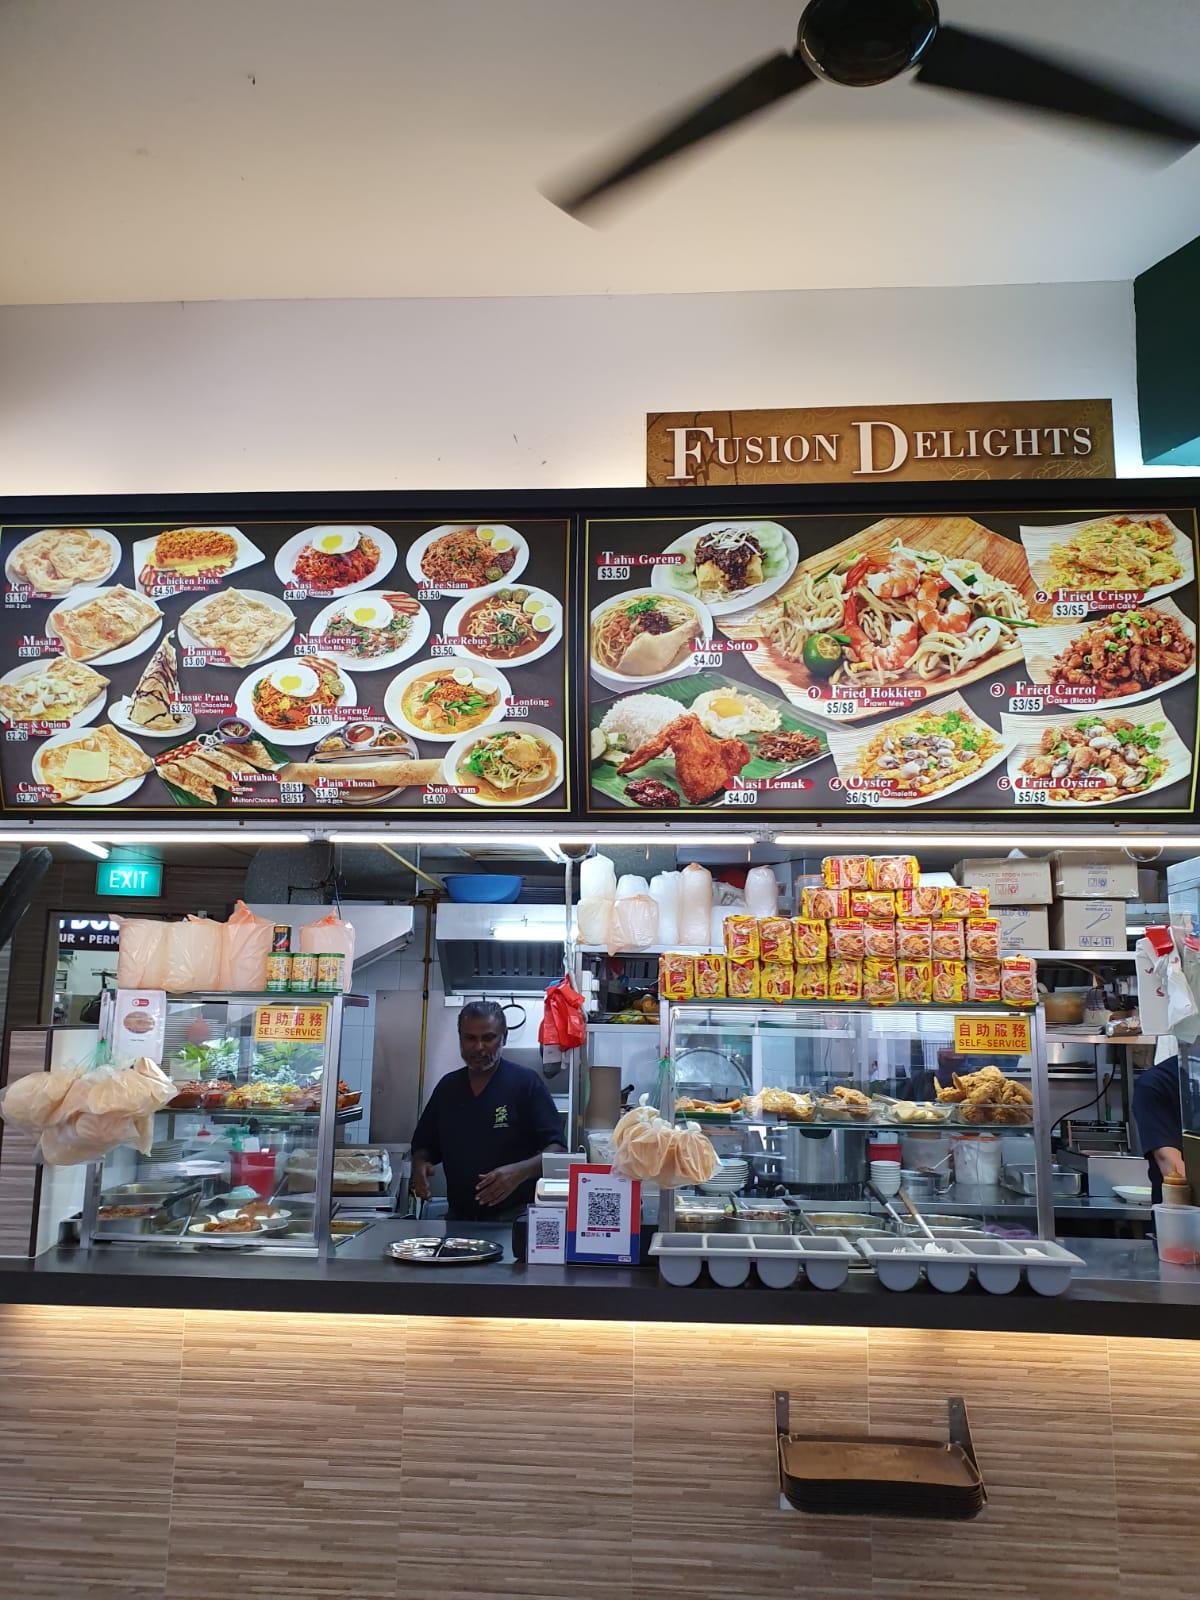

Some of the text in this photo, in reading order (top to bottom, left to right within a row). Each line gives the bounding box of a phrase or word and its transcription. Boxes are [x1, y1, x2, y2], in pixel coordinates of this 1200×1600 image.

[665, 420, 1094, 481] FUSION DELIGHTS
[601, 551, 682, 566] Tahu Goreng
[157, 573, 220, 585] Chicken Floss
[600, 567, 628, 579] $3.50
[290, 580, 312, 590] Nasi
[421, 579, 469, 590] Mee Siam
[153, 586, 175, 596] $4.50
[285, 590, 306, 600] $4.00
[419, 590, 440, 600] $3.50
[1058, 588, 1094, 601] Fried
[1098, 590, 1139, 603] Crispy
[1056, 604, 1084, 616] $3/$5
[23, 635, 58, 646] Masala
[299, 632, 357, 646] Nasi Goreng
[434, 633, 488, 646] Mee Rebus
[694, 637, 753, 651] Mee Soto
[19, 647, 40, 656] $3.00
[187, 645, 223, 656] Banana
[295, 645, 316, 655] $4.50
[431, 646, 454, 656] $3.50
[184, 656, 205, 666] $3.00
[693, 653, 721, 665] $4.00
[831, 685, 867, 699] Fried
[870, 687, 922, 698] Hokkien
[1015, 681, 1051, 696] Fried
[1055, 683, 1097, 696] Carrot
[173, 690, 230, 702] Tissue Prata
[510, 695, 550, 708] Lontong
[1046, 695, 1069, 704] Cake
[171, 704, 192, 713] $3.20
[826, 702, 854, 714] $5/$8
[863, 698, 905, 707] Prawn Mee
[1012, 699, 1041, 711] $3/$5
[310, 703, 333, 715] Mee
[506, 707, 528, 716] $3.50
[40, 719, 67, 729] Onion
[309, 716, 330, 725] $4.00
[231, 771, 279, 782] Murtabak
[318, 776, 376, 788] Plain Thosai
[732, 775, 805, 790] Nasi Lemak
[18, 782, 51, 792] Cheese
[849, 776, 894, 790] Oyster
[1021, 776, 1056, 789] Fried
[1060, 780, 1102, 790] Oyster
[316, 788, 338, 797] $1.60
[426, 783, 476, 797] Soto Ayam
[881, 788, 918, 798] Omelette
[17, 793, 38, 802] $2.70
[424, 794, 445, 803] $4.00
[728, 791, 755, 804] $4.00
[846, 791, 880, 804] $6/$10
[1018, 791, 1046, 803] $5/$8
[109, 869, 149, 889] EXIT
[260, 1011, 322, 1027] 自助服務
[258, 1026, 321, 1037] SELF-SERVICE
[959, 1022, 1027, 1038] 自助服務
[958, 1038, 1027, 1048] SELF-SERVICE
